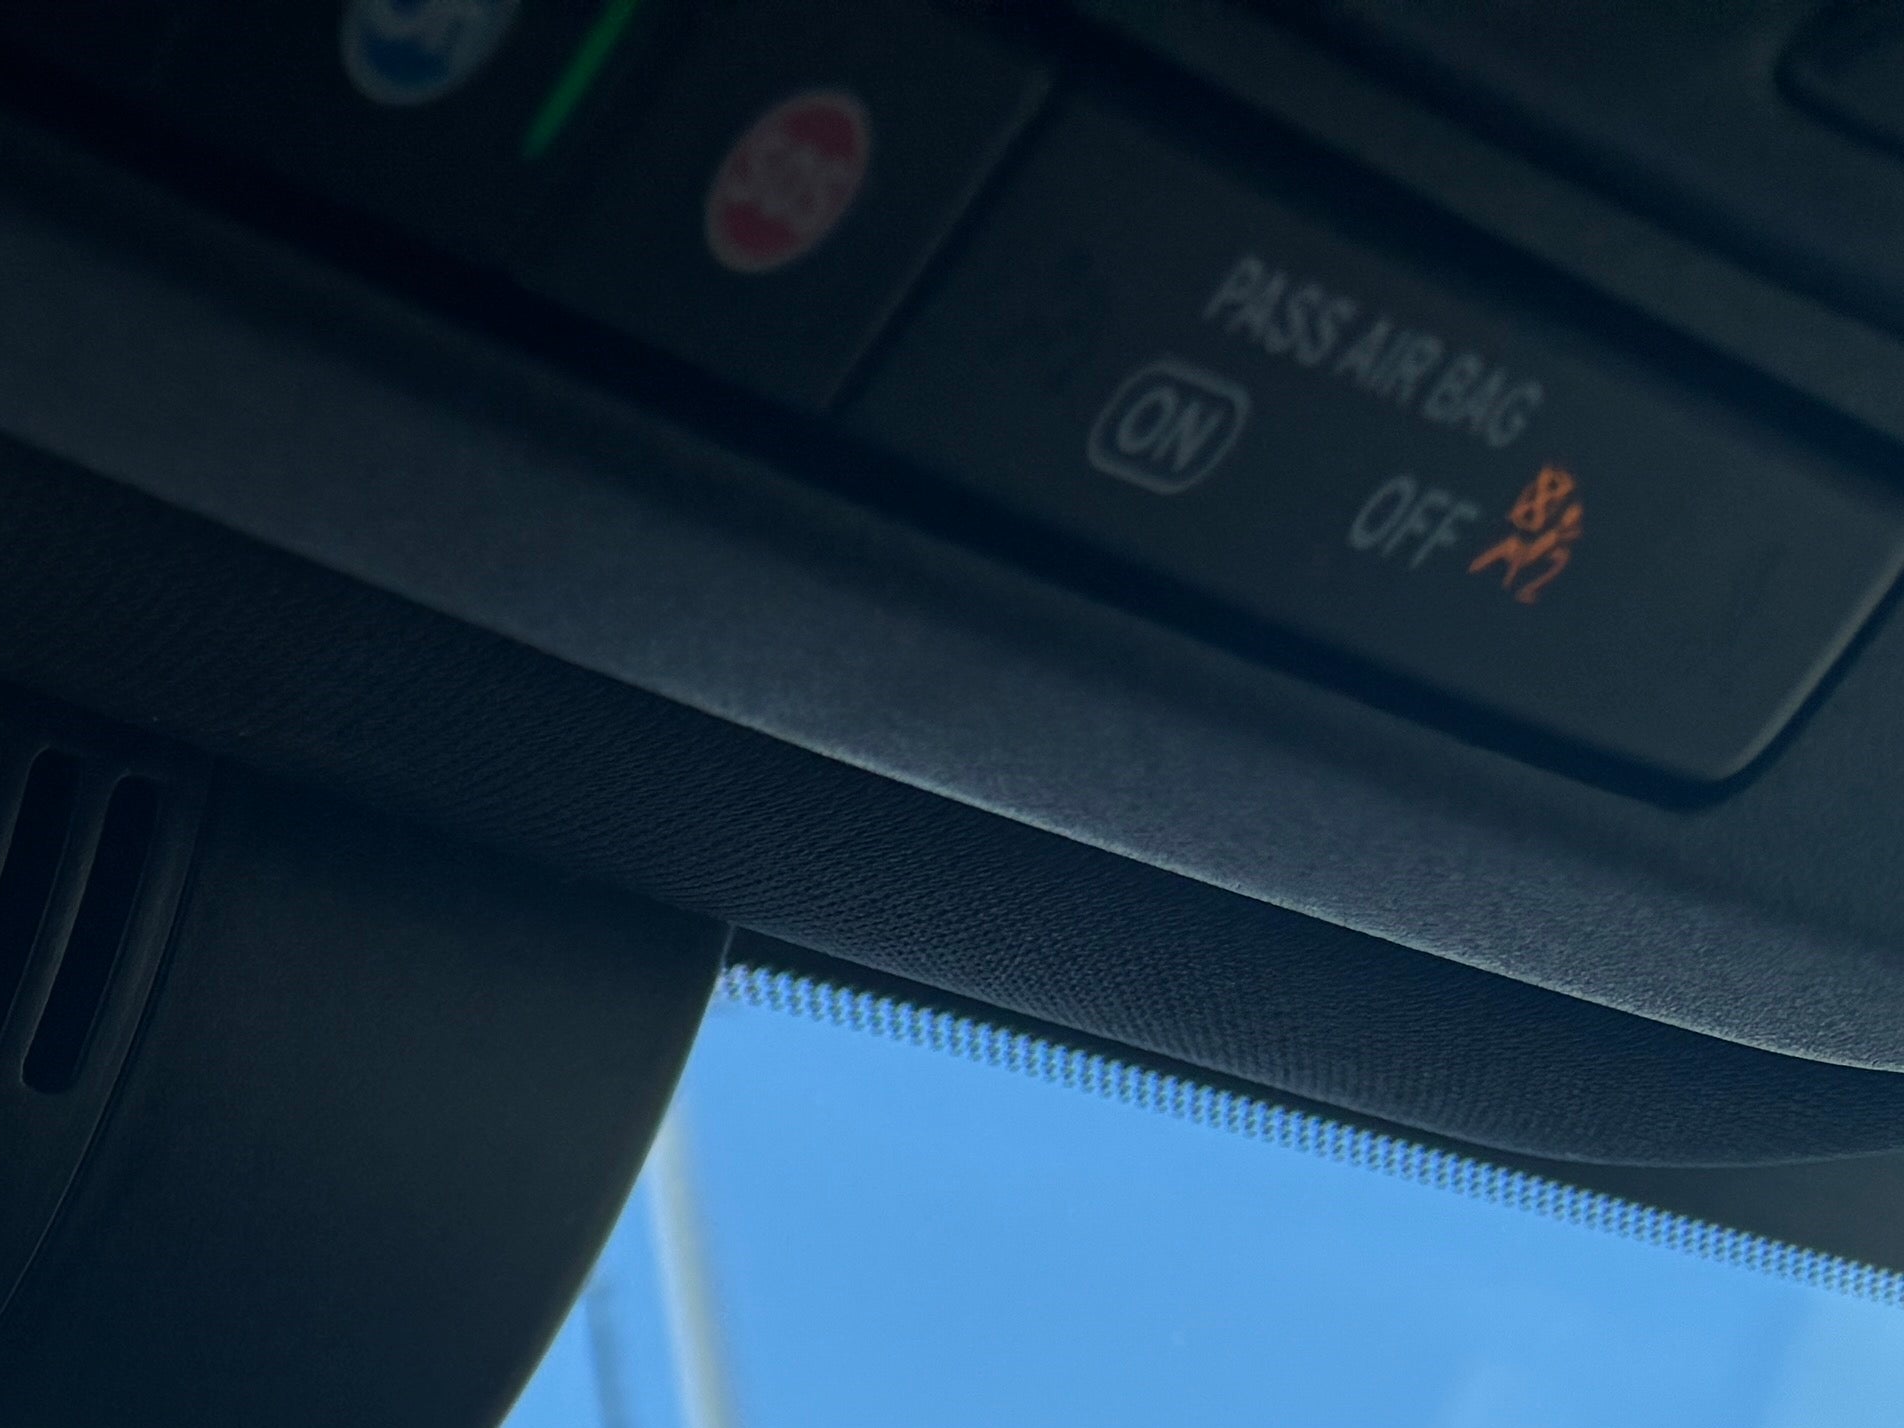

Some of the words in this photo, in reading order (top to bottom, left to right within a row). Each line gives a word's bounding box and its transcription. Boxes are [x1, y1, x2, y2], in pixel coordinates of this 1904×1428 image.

[1204, 255, 1360, 366] PASS
[1335, 318, 1444, 402] AIR
[1422, 351, 1544, 449] BAG
[1116, 385, 1225, 473] ON
[1347, 473, 1480, 569] OFF
